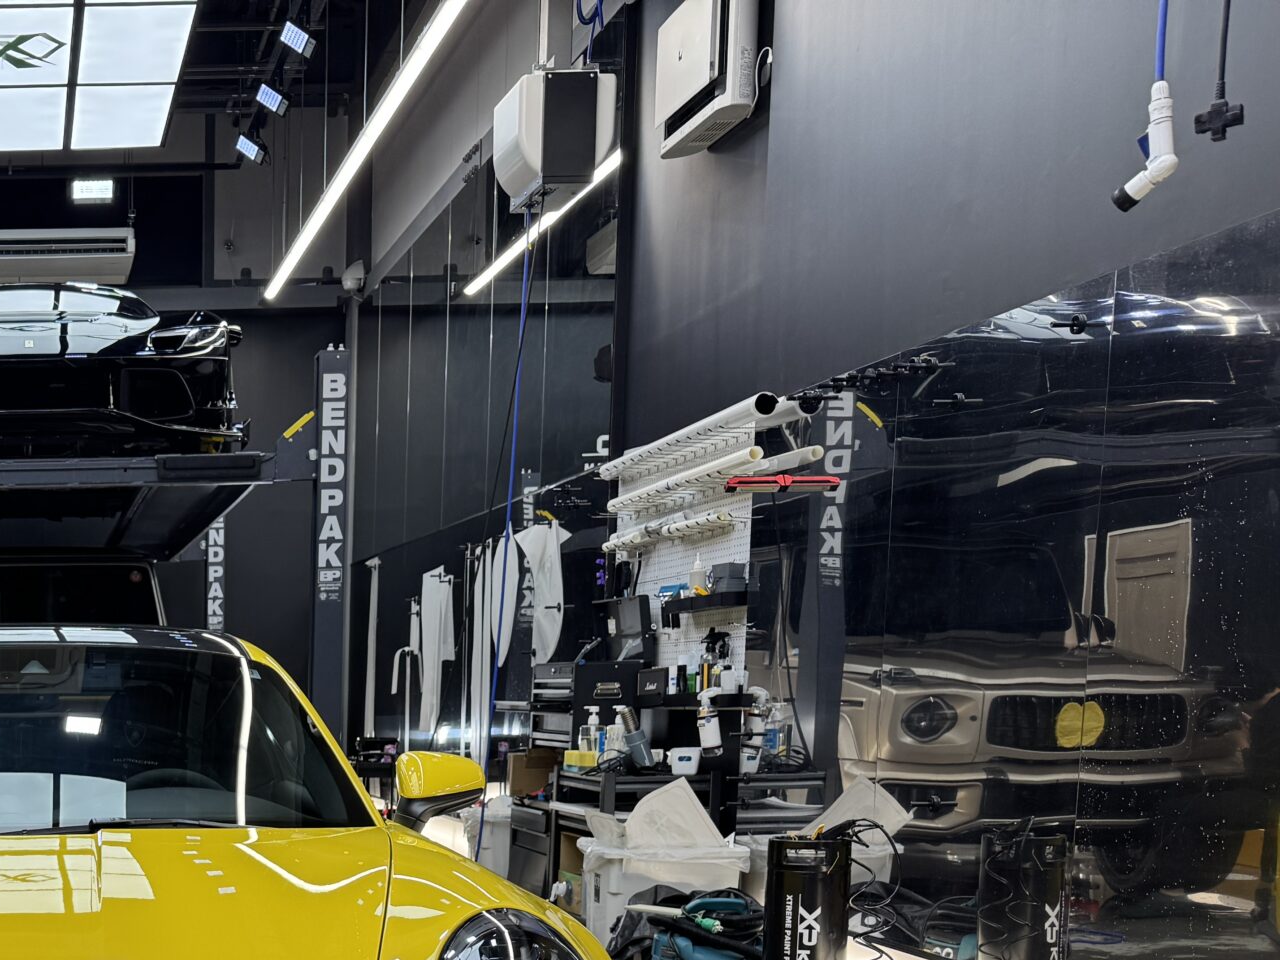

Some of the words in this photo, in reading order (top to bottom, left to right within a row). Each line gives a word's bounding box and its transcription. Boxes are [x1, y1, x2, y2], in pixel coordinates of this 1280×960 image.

[318, 373, 347, 568] BENDPAK
[785, 894, 794, 928] XTREME
[798, 905, 821, 946] XP
[783, 930, 792, 955] PAINT
